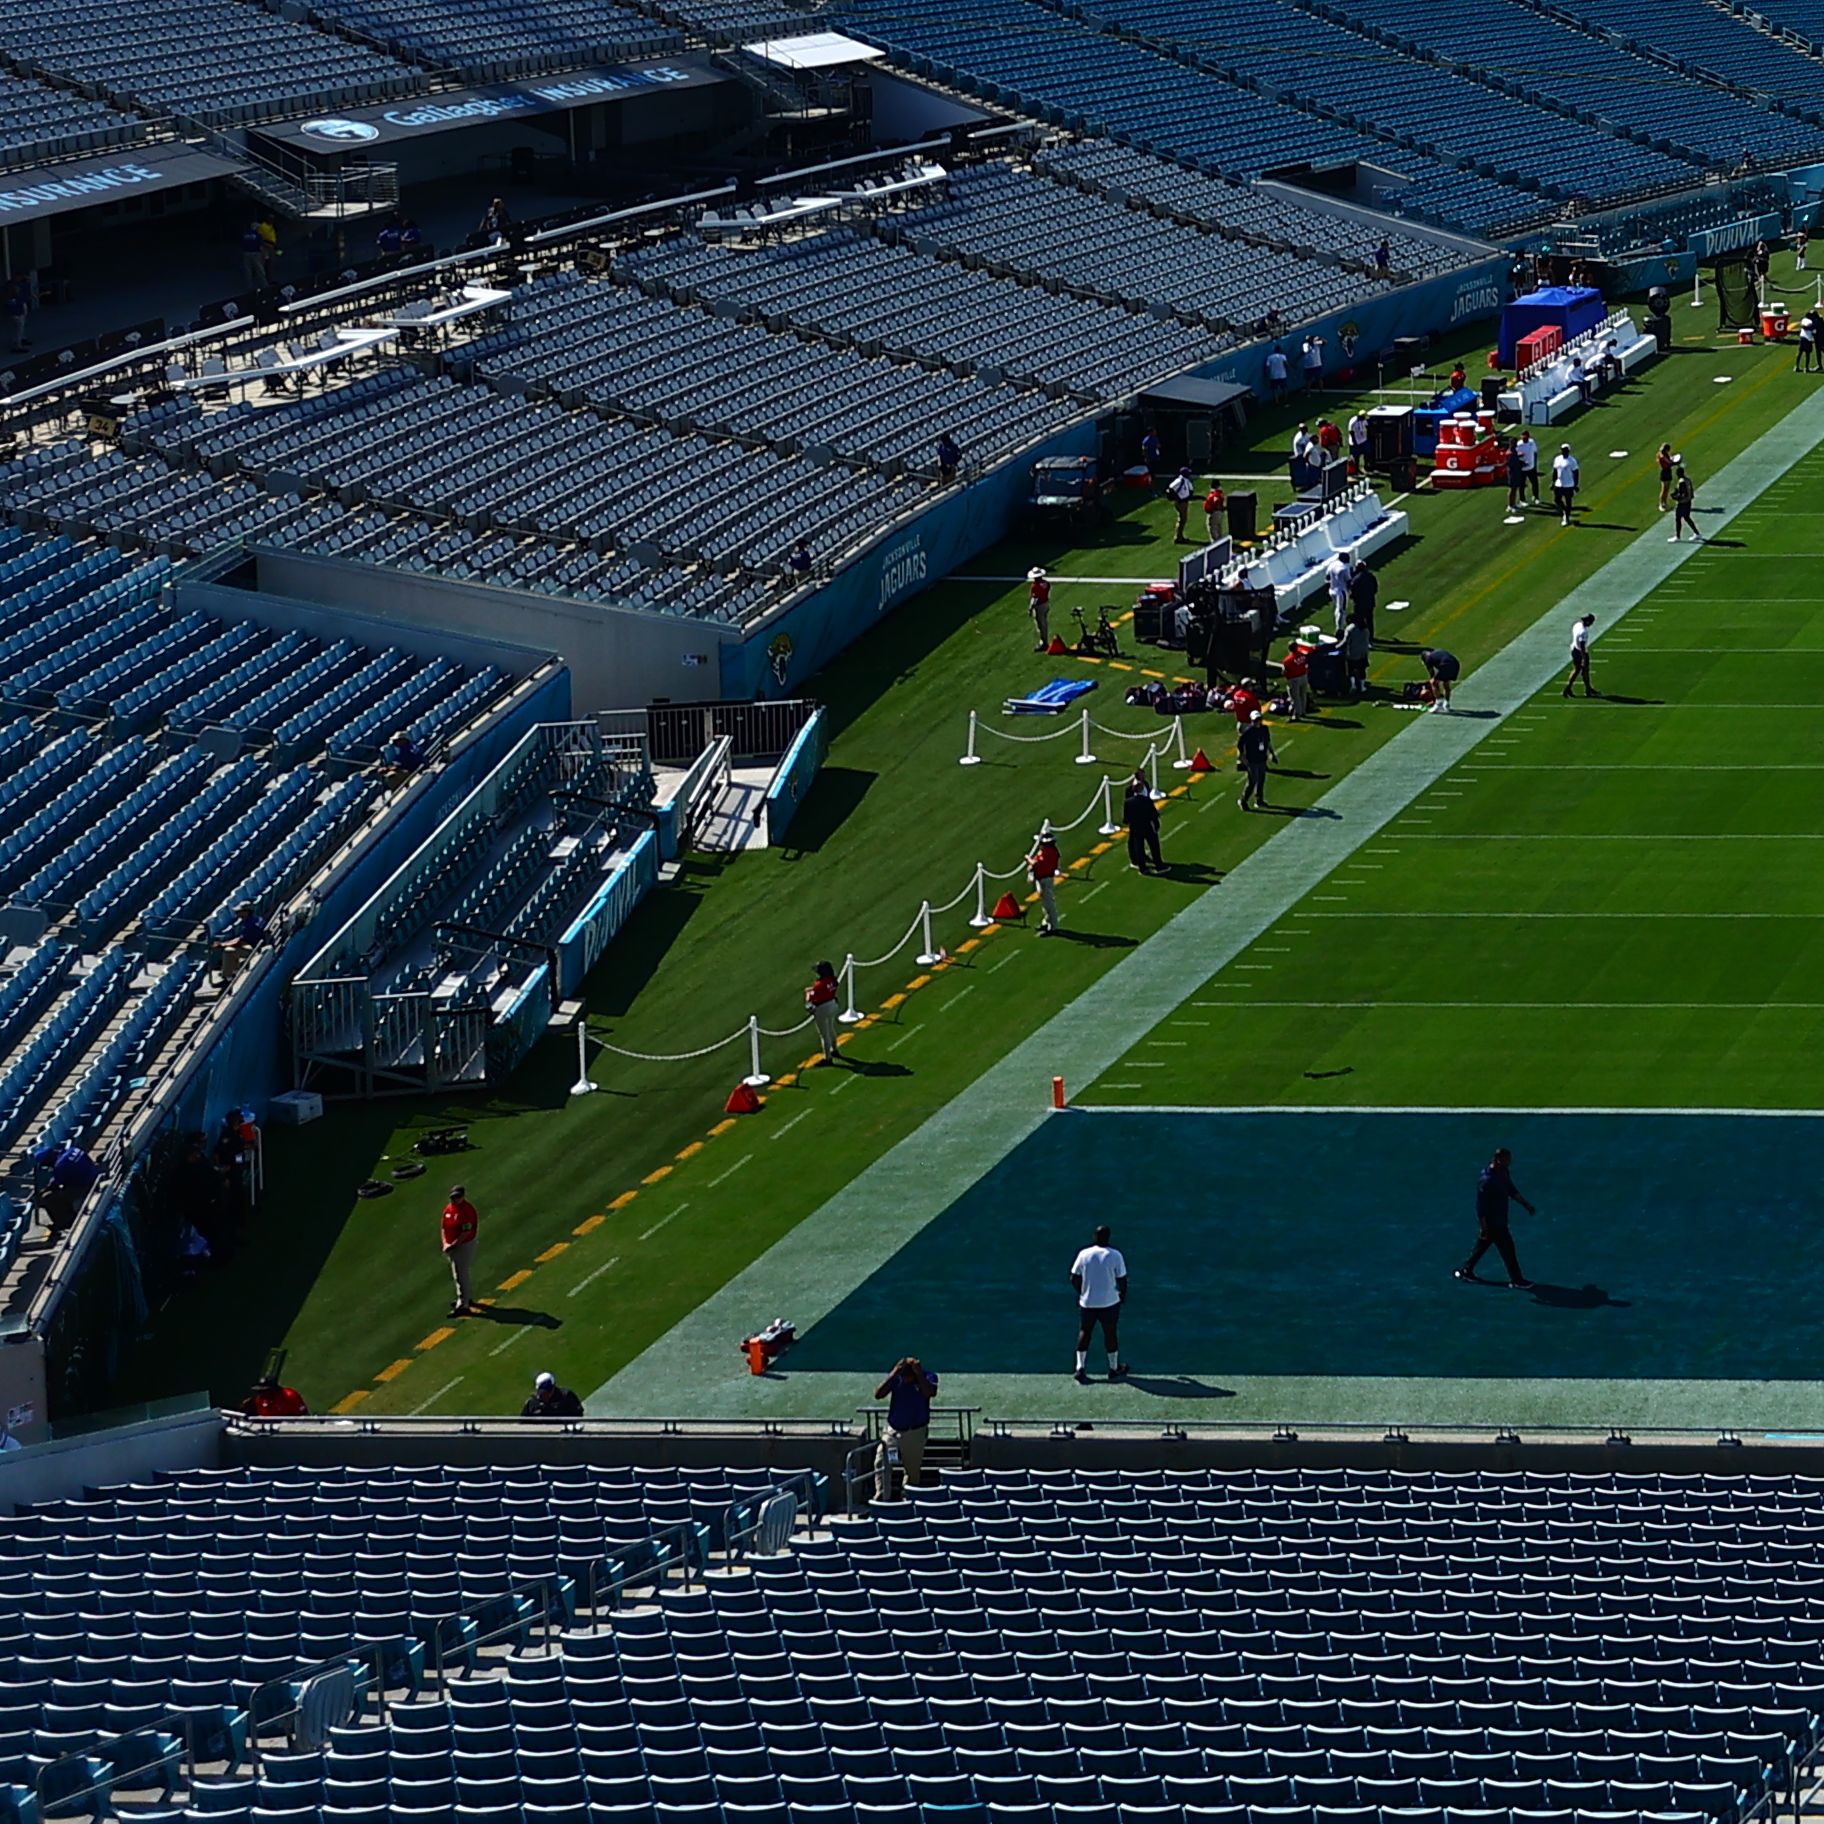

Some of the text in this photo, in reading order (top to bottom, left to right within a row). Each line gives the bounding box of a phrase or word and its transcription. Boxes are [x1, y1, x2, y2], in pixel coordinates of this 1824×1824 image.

[383, 66, 690, 127] Gallagher INSURANCE
[1450, 287, 1499, 323] JAGUARS
[1774, 319, 1785, 332] G
[1446, 457, 1458, 469] G
[882, 533, 921, 571] JACKSONVILLE
[878, 550, 927, 612] JAGUARS
